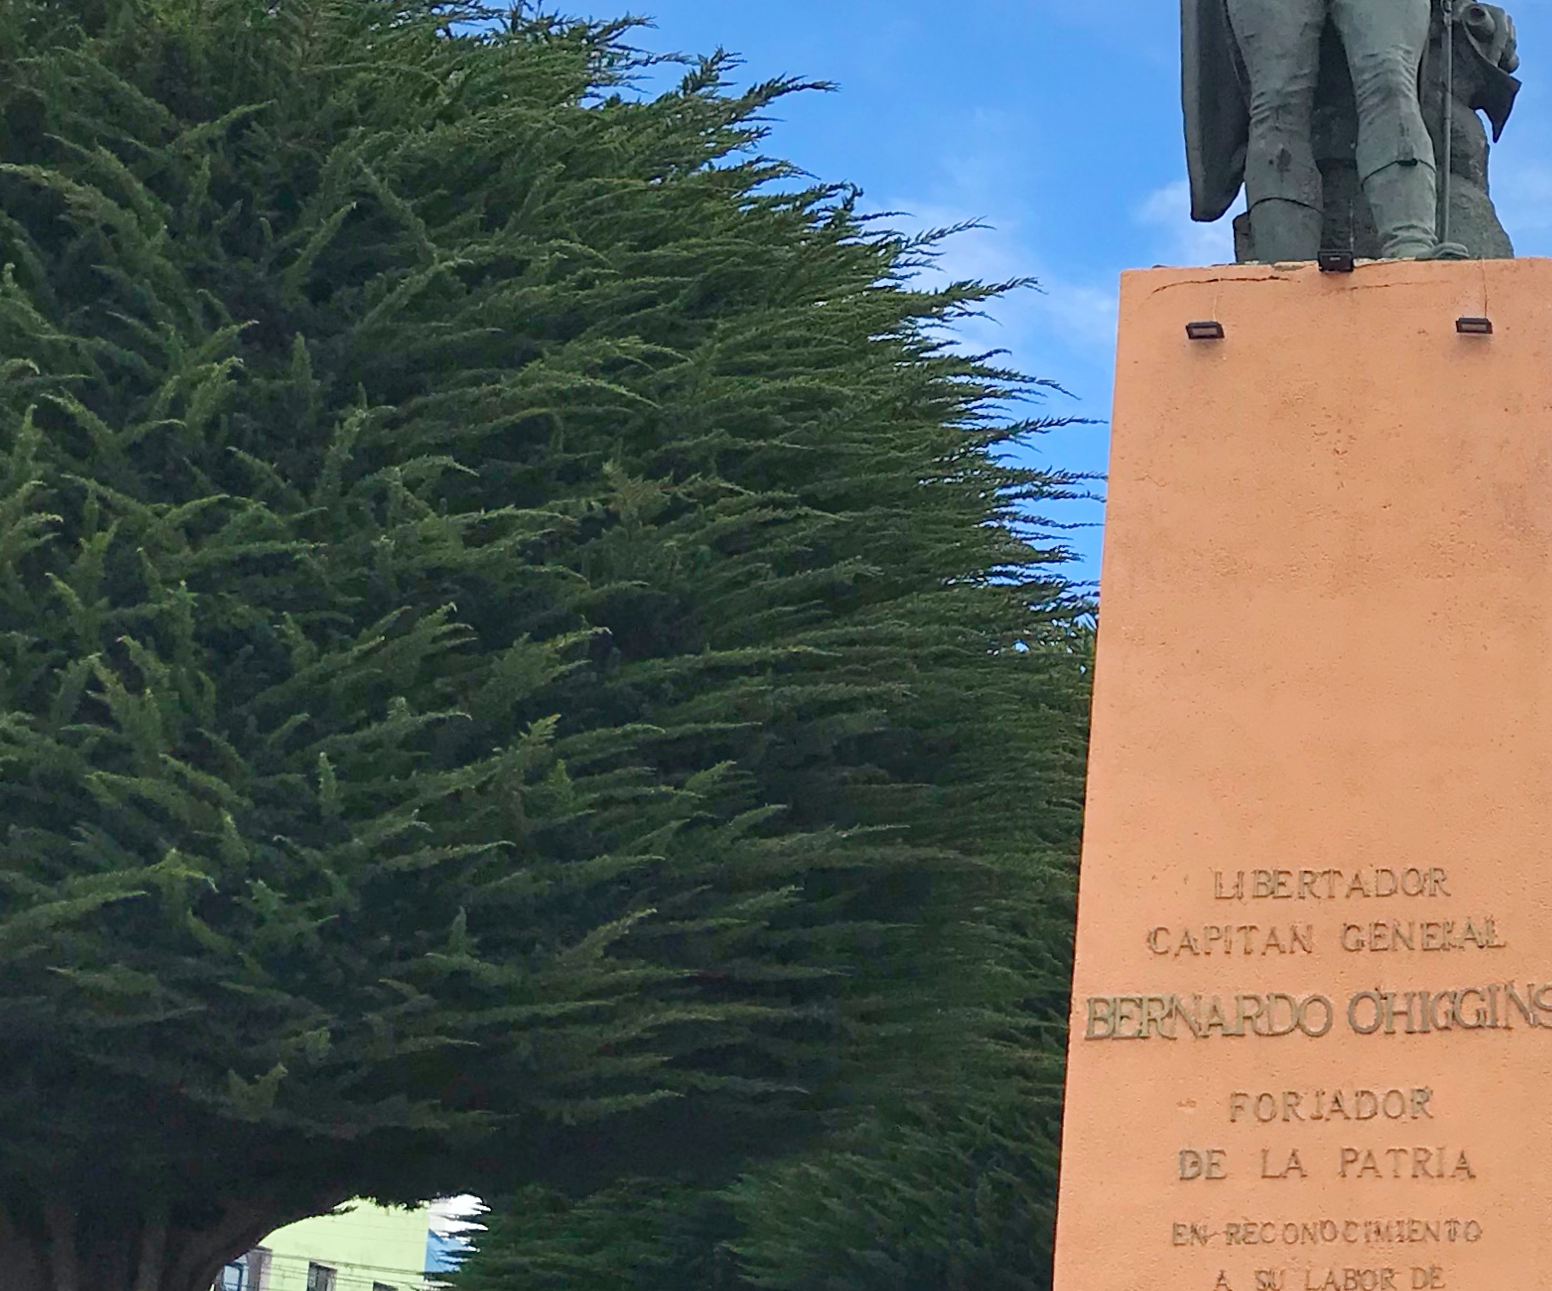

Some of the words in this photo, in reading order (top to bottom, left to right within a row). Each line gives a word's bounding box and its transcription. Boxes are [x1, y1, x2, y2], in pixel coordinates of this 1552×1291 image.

[1213, 866, 1452, 901] LIBERTADOR
[1147, 923, 1314, 957] CAPITAN
[1339, 917, 1508, 953] GENERAL
[1084, 991, 1334, 1041] BERNARDO
[1229, 1086, 1435, 1123] FORJADOR
[1178, 1148, 1229, 1182] DE
[1260, 1147, 1309, 1180] LA
[1338, 1146, 1477, 1180] PATRIA
[1171, 1222, 1208, 1247] EN
[1224, 1218, 1484, 1246] RECONOCIMIENTO
[1409, 1265, 1447, 1291] DE
